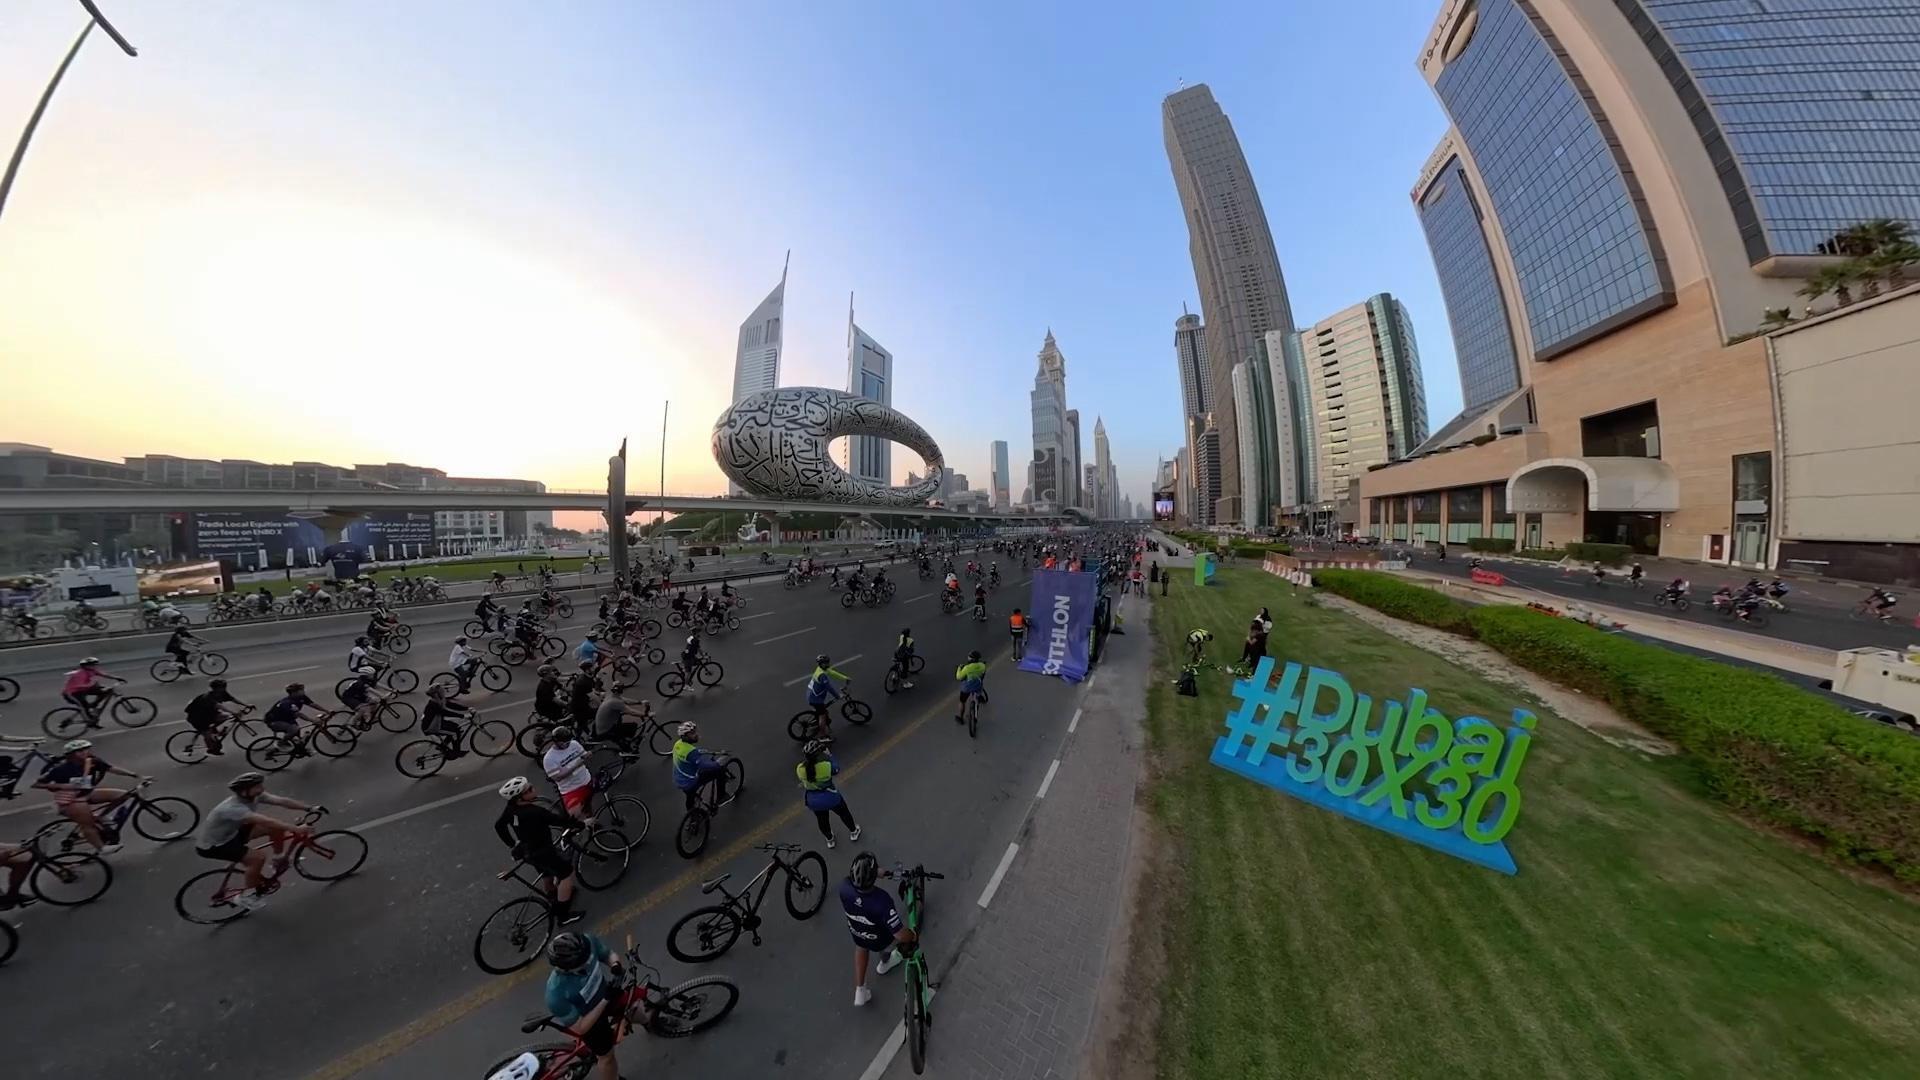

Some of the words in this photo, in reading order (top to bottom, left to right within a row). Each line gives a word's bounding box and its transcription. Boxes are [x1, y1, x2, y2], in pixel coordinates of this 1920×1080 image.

[1417, 140, 1454, 190] MILLENNIUM
[198, 520, 224, 528] Trade
[225, 520, 249, 528] Local
[250, 520, 281, 529] Equities
[1223, 656, 1537, 777] #Dubai
[1285, 729, 1522, 845] 30X30
